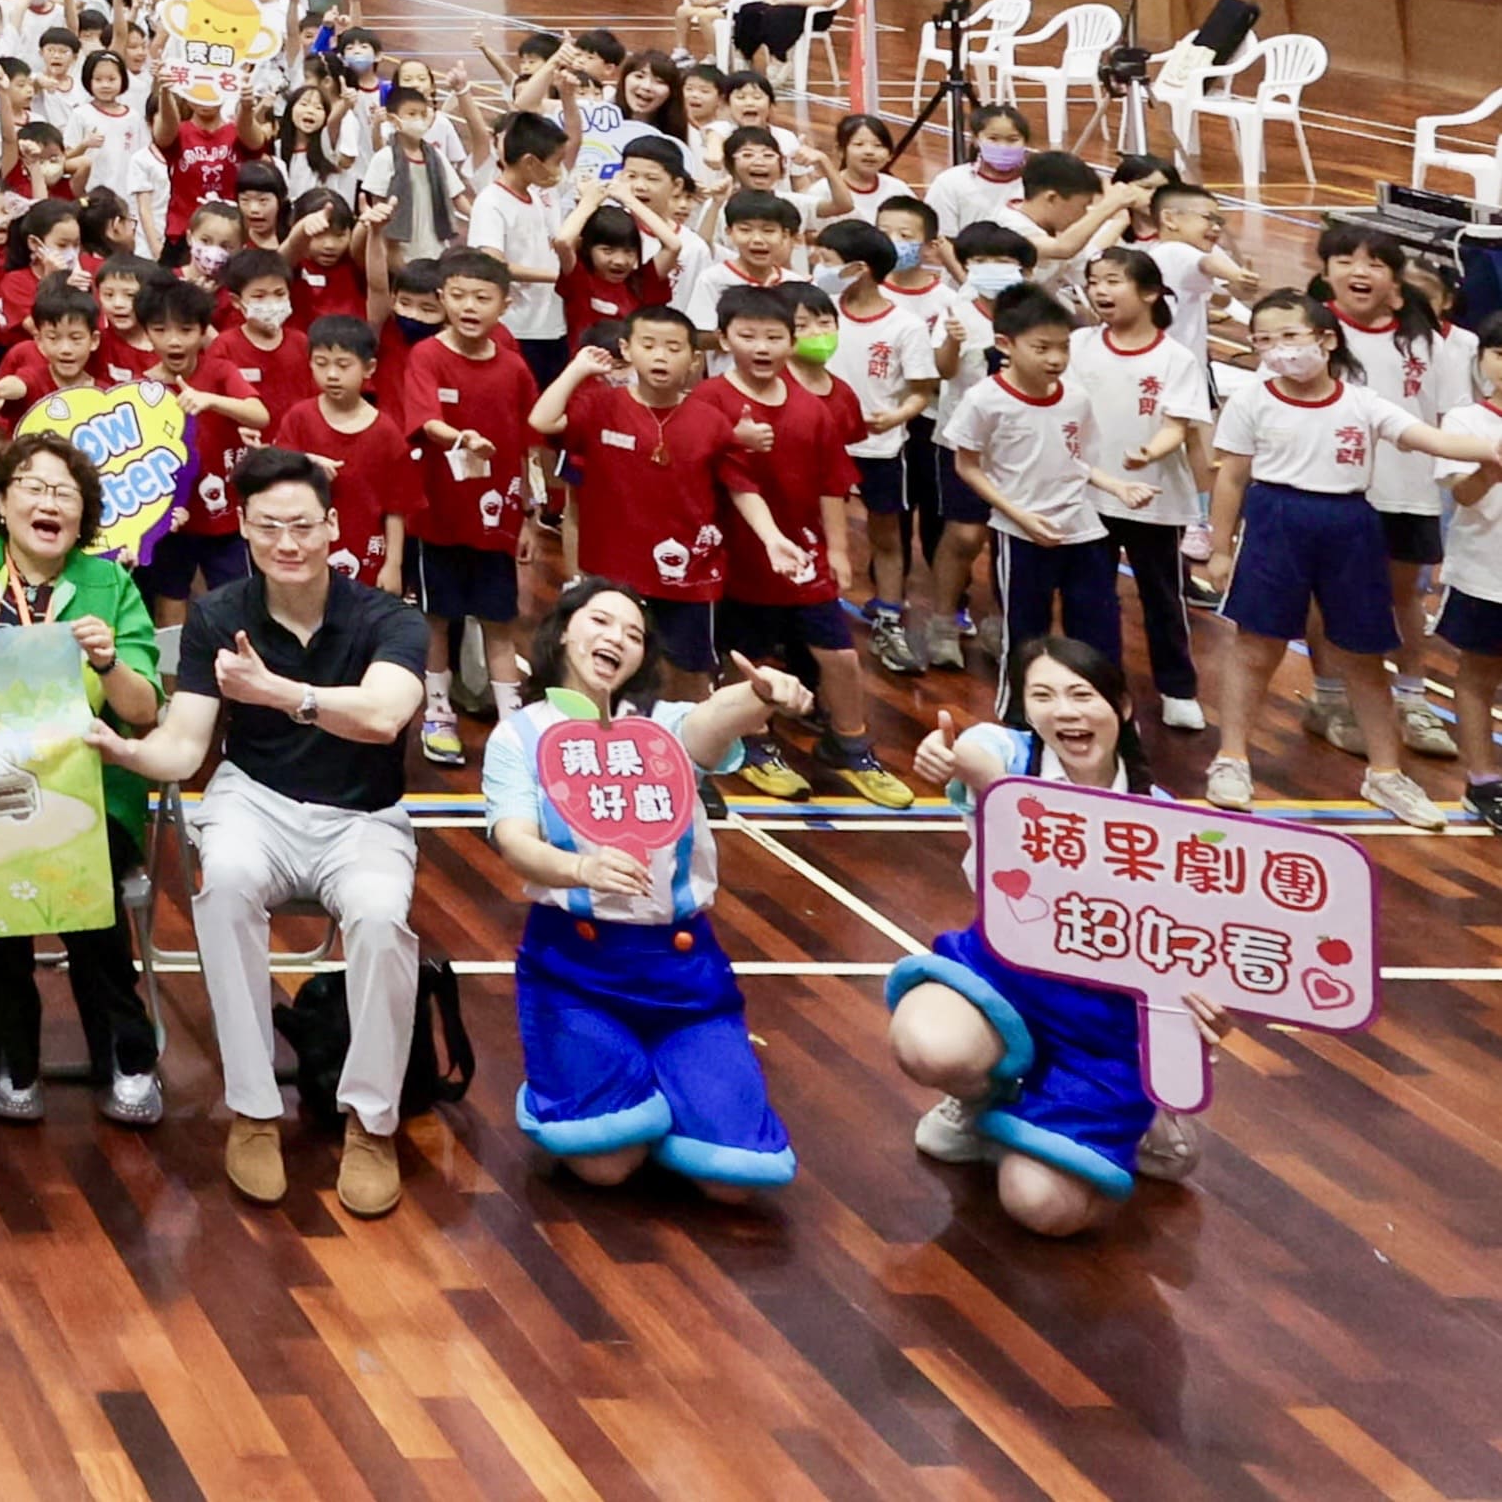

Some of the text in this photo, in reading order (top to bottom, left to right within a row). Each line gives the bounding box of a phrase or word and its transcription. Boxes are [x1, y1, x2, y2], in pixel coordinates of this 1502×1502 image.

[171, 66, 238, 91] 第一名
[868, 341, 893, 379] 秀朗
[76, 403, 142, 467] ow
[1335, 425, 1366, 467] 秀朗
[99, 449, 183, 527] ter
[559, 738, 644, 778] 蘋果
[588, 783, 675, 824] 好戲
[1020, 809, 1328, 913] 蘋果劇團
[1055, 891, 1292, 995] 超好看
